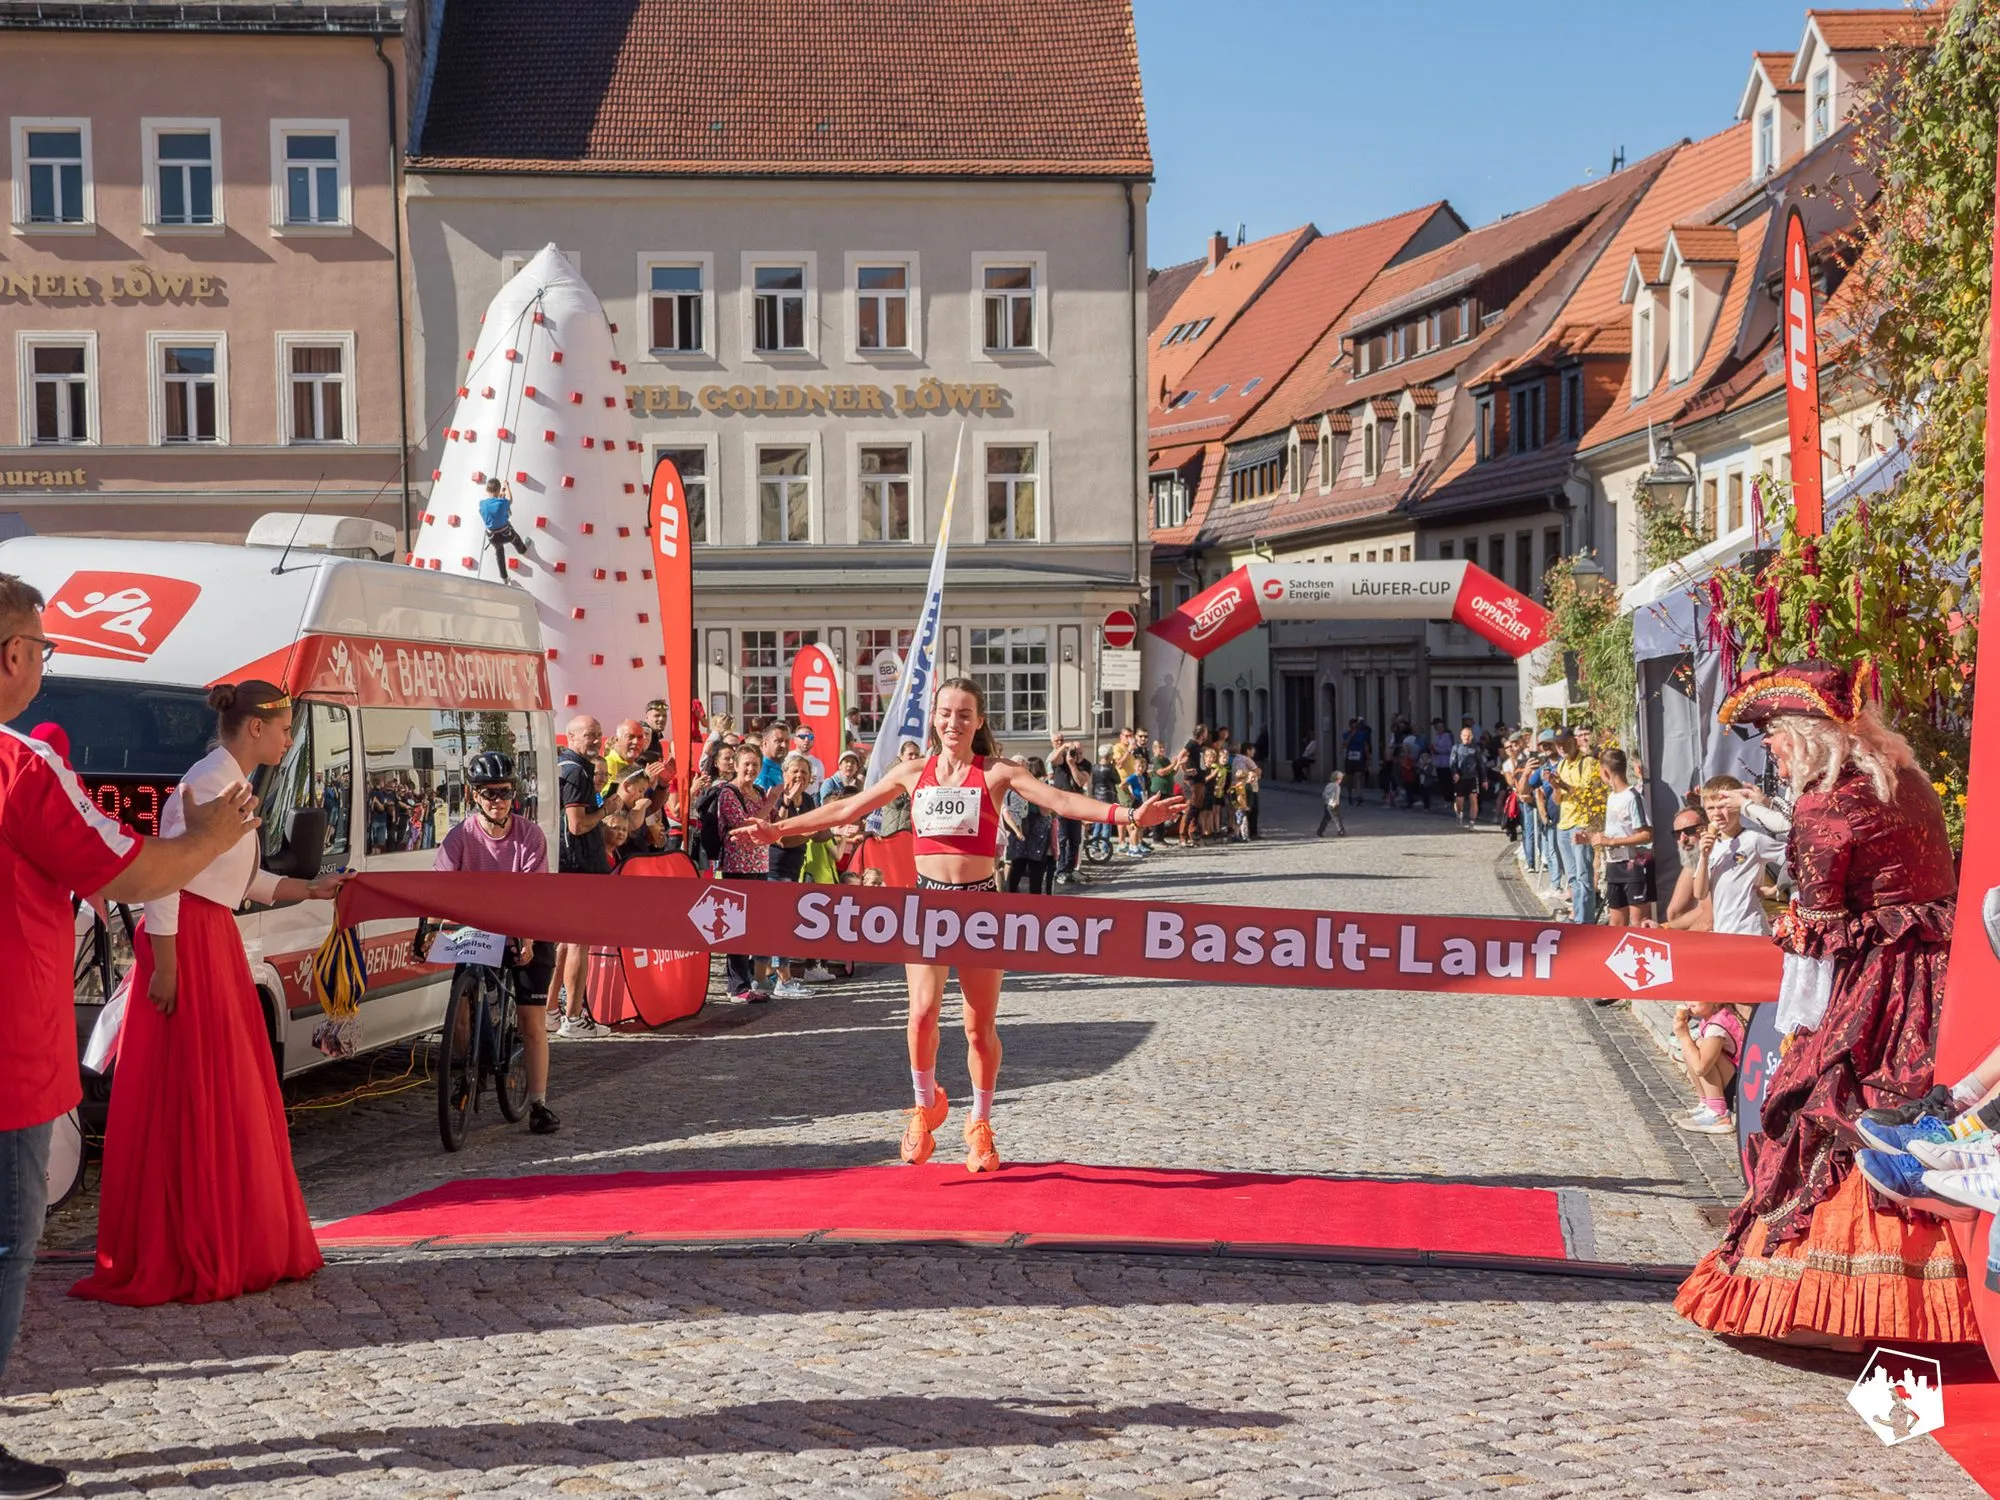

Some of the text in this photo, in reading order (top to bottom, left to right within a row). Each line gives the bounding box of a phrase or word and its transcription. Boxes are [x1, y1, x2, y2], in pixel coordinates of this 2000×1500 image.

[0, 263, 216, 298] NER LÖWE
[699, 384, 882, 411] GOLDNER
[895, 377, 1001, 411] LÖWE
[1289, 579, 1334, 589] Sachsen
[1289, 590, 1330, 600] Energie
[1352, 579, 1451, 596] LÄUFER-CUP
[1199, 601, 1231, 628] ZVON
[1471, 596, 1531, 641] OPPACHER
[396, 648, 521, 700] BAER-SERVICE
[925, 800, 965, 816] 3490
[794, 892, 1561, 979] Stolpener Basalt-Lauf
[362, 944, 391, 976] BEN
[391, 941, 410, 970] DIE
